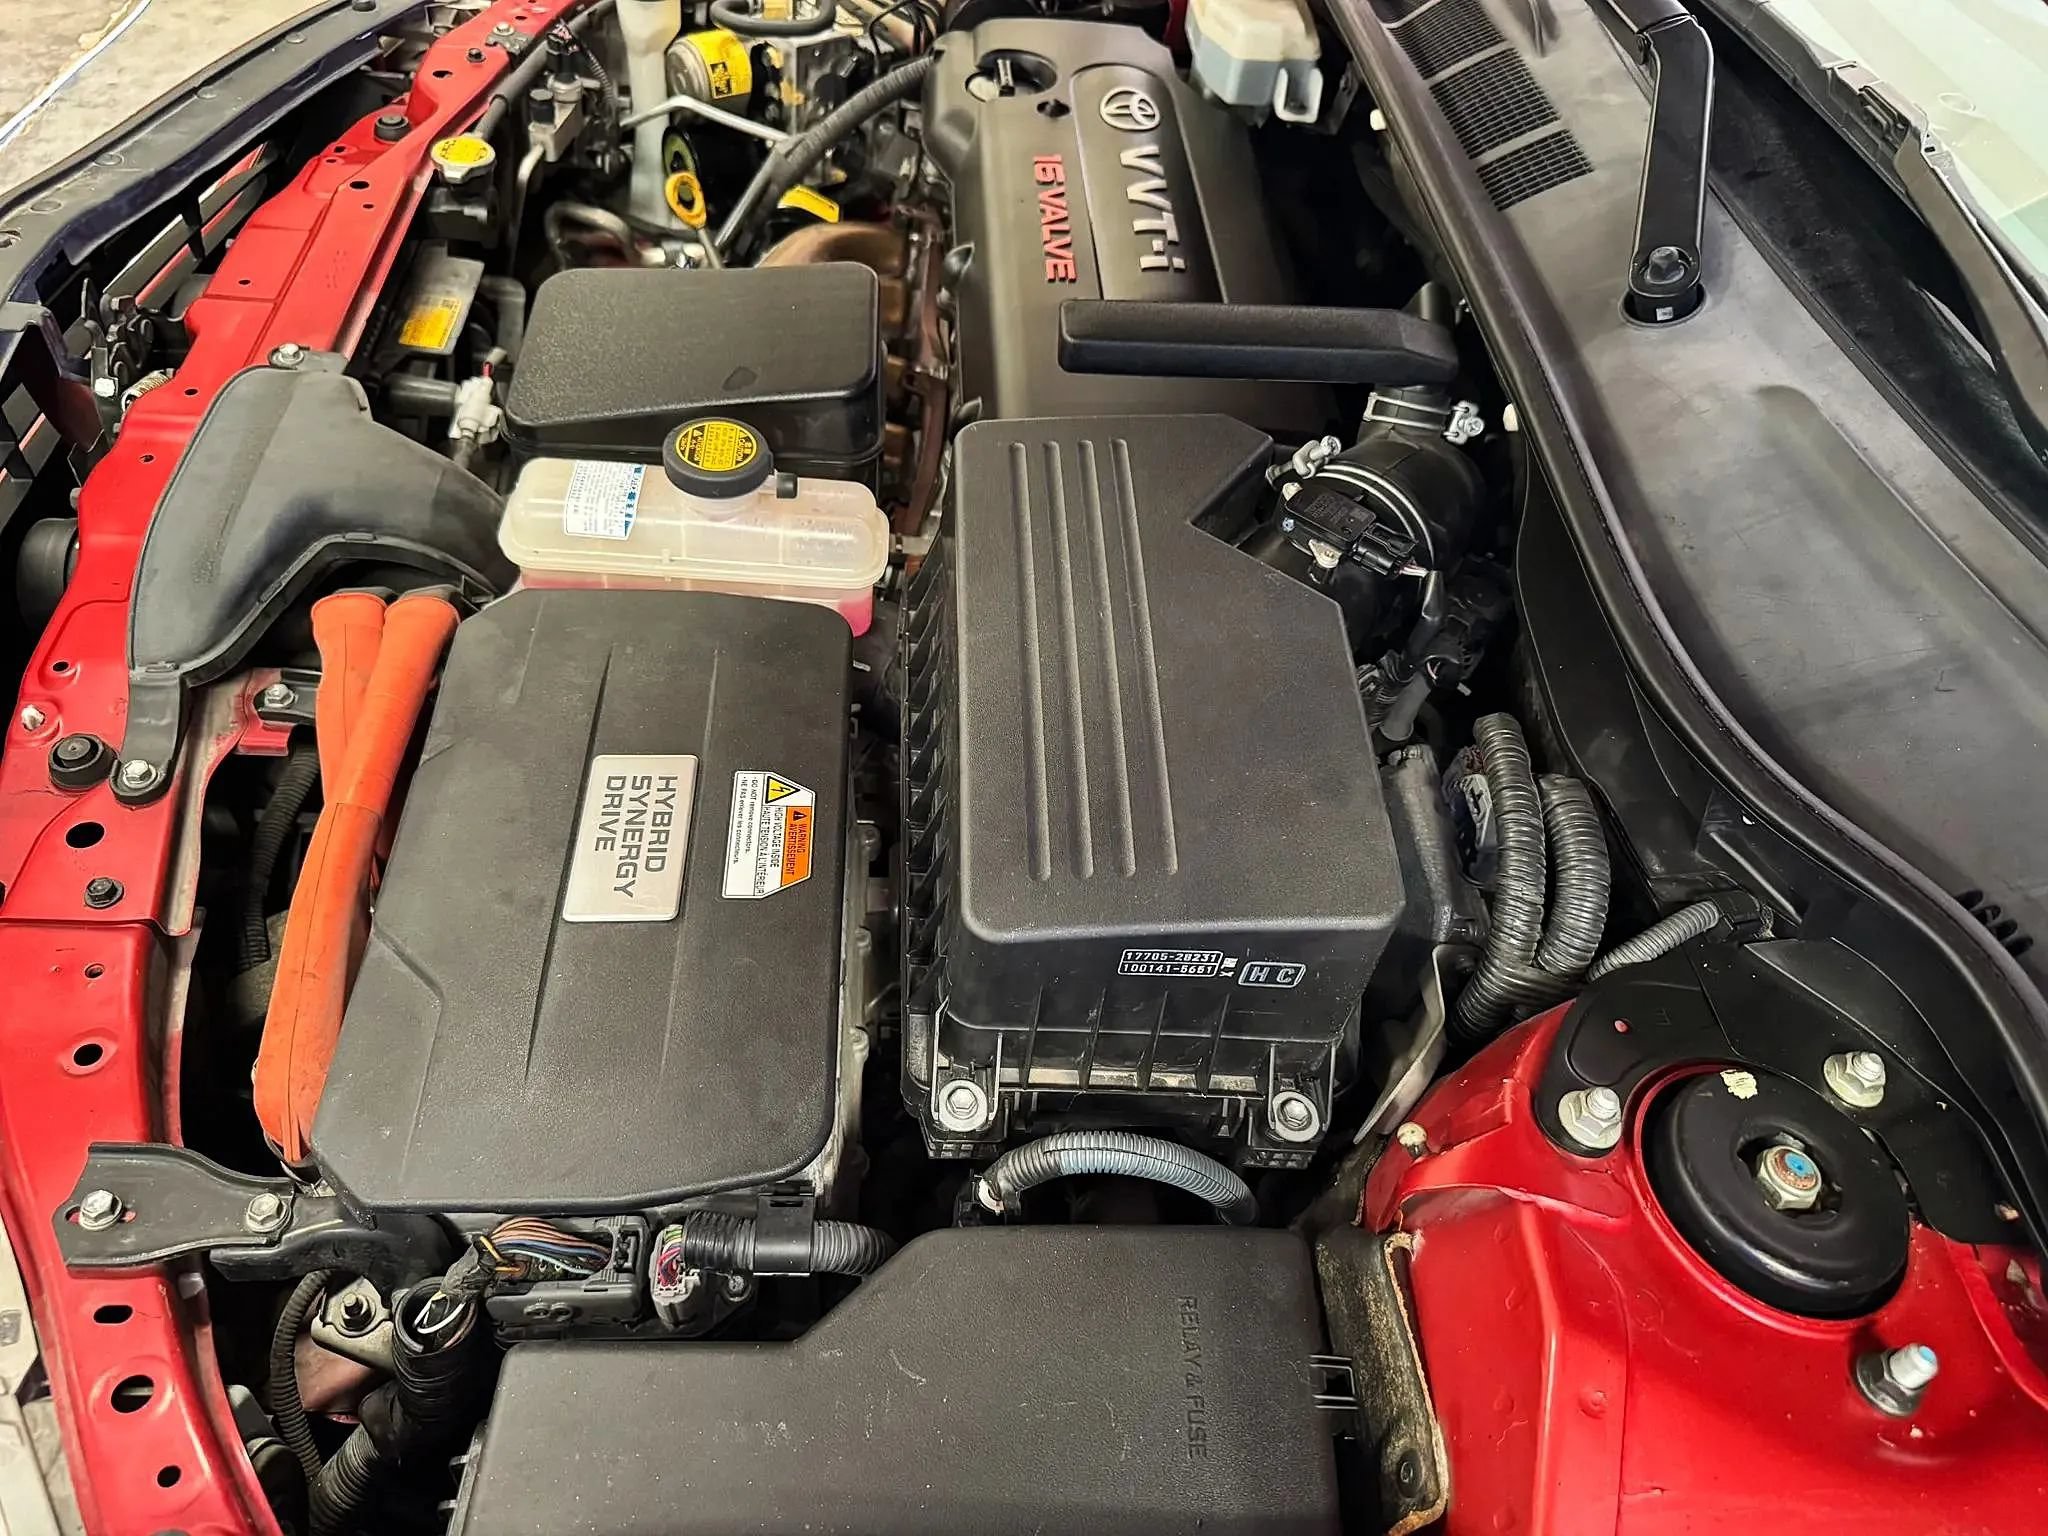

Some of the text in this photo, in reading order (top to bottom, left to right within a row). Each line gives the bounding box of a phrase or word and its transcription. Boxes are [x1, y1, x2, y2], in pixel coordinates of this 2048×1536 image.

[1033, 154, 1078, 283] 16 VALVE
[1119, 145, 1186, 271] VVT-i
[594, 775, 627, 852] DRIVE
[739, 788, 747, 799] PAS
[748, 801, 756, 821] remove
[750, 789, 758, 800] NOT
[761, 806, 772, 824] HAUTE
[613, 775, 652, 899] SYNERGY
[644, 775, 679, 873] HYBRID
[759, 825, 770, 851] TENSION
[769, 807, 784, 868] HIGH VOLTAGE INSIDE
[785, 823, 799, 875] AVERTISSEMENT
[796, 823, 807, 853] WARNING
[1179, 1296, 1207, 1460] RELAY & FUSE
